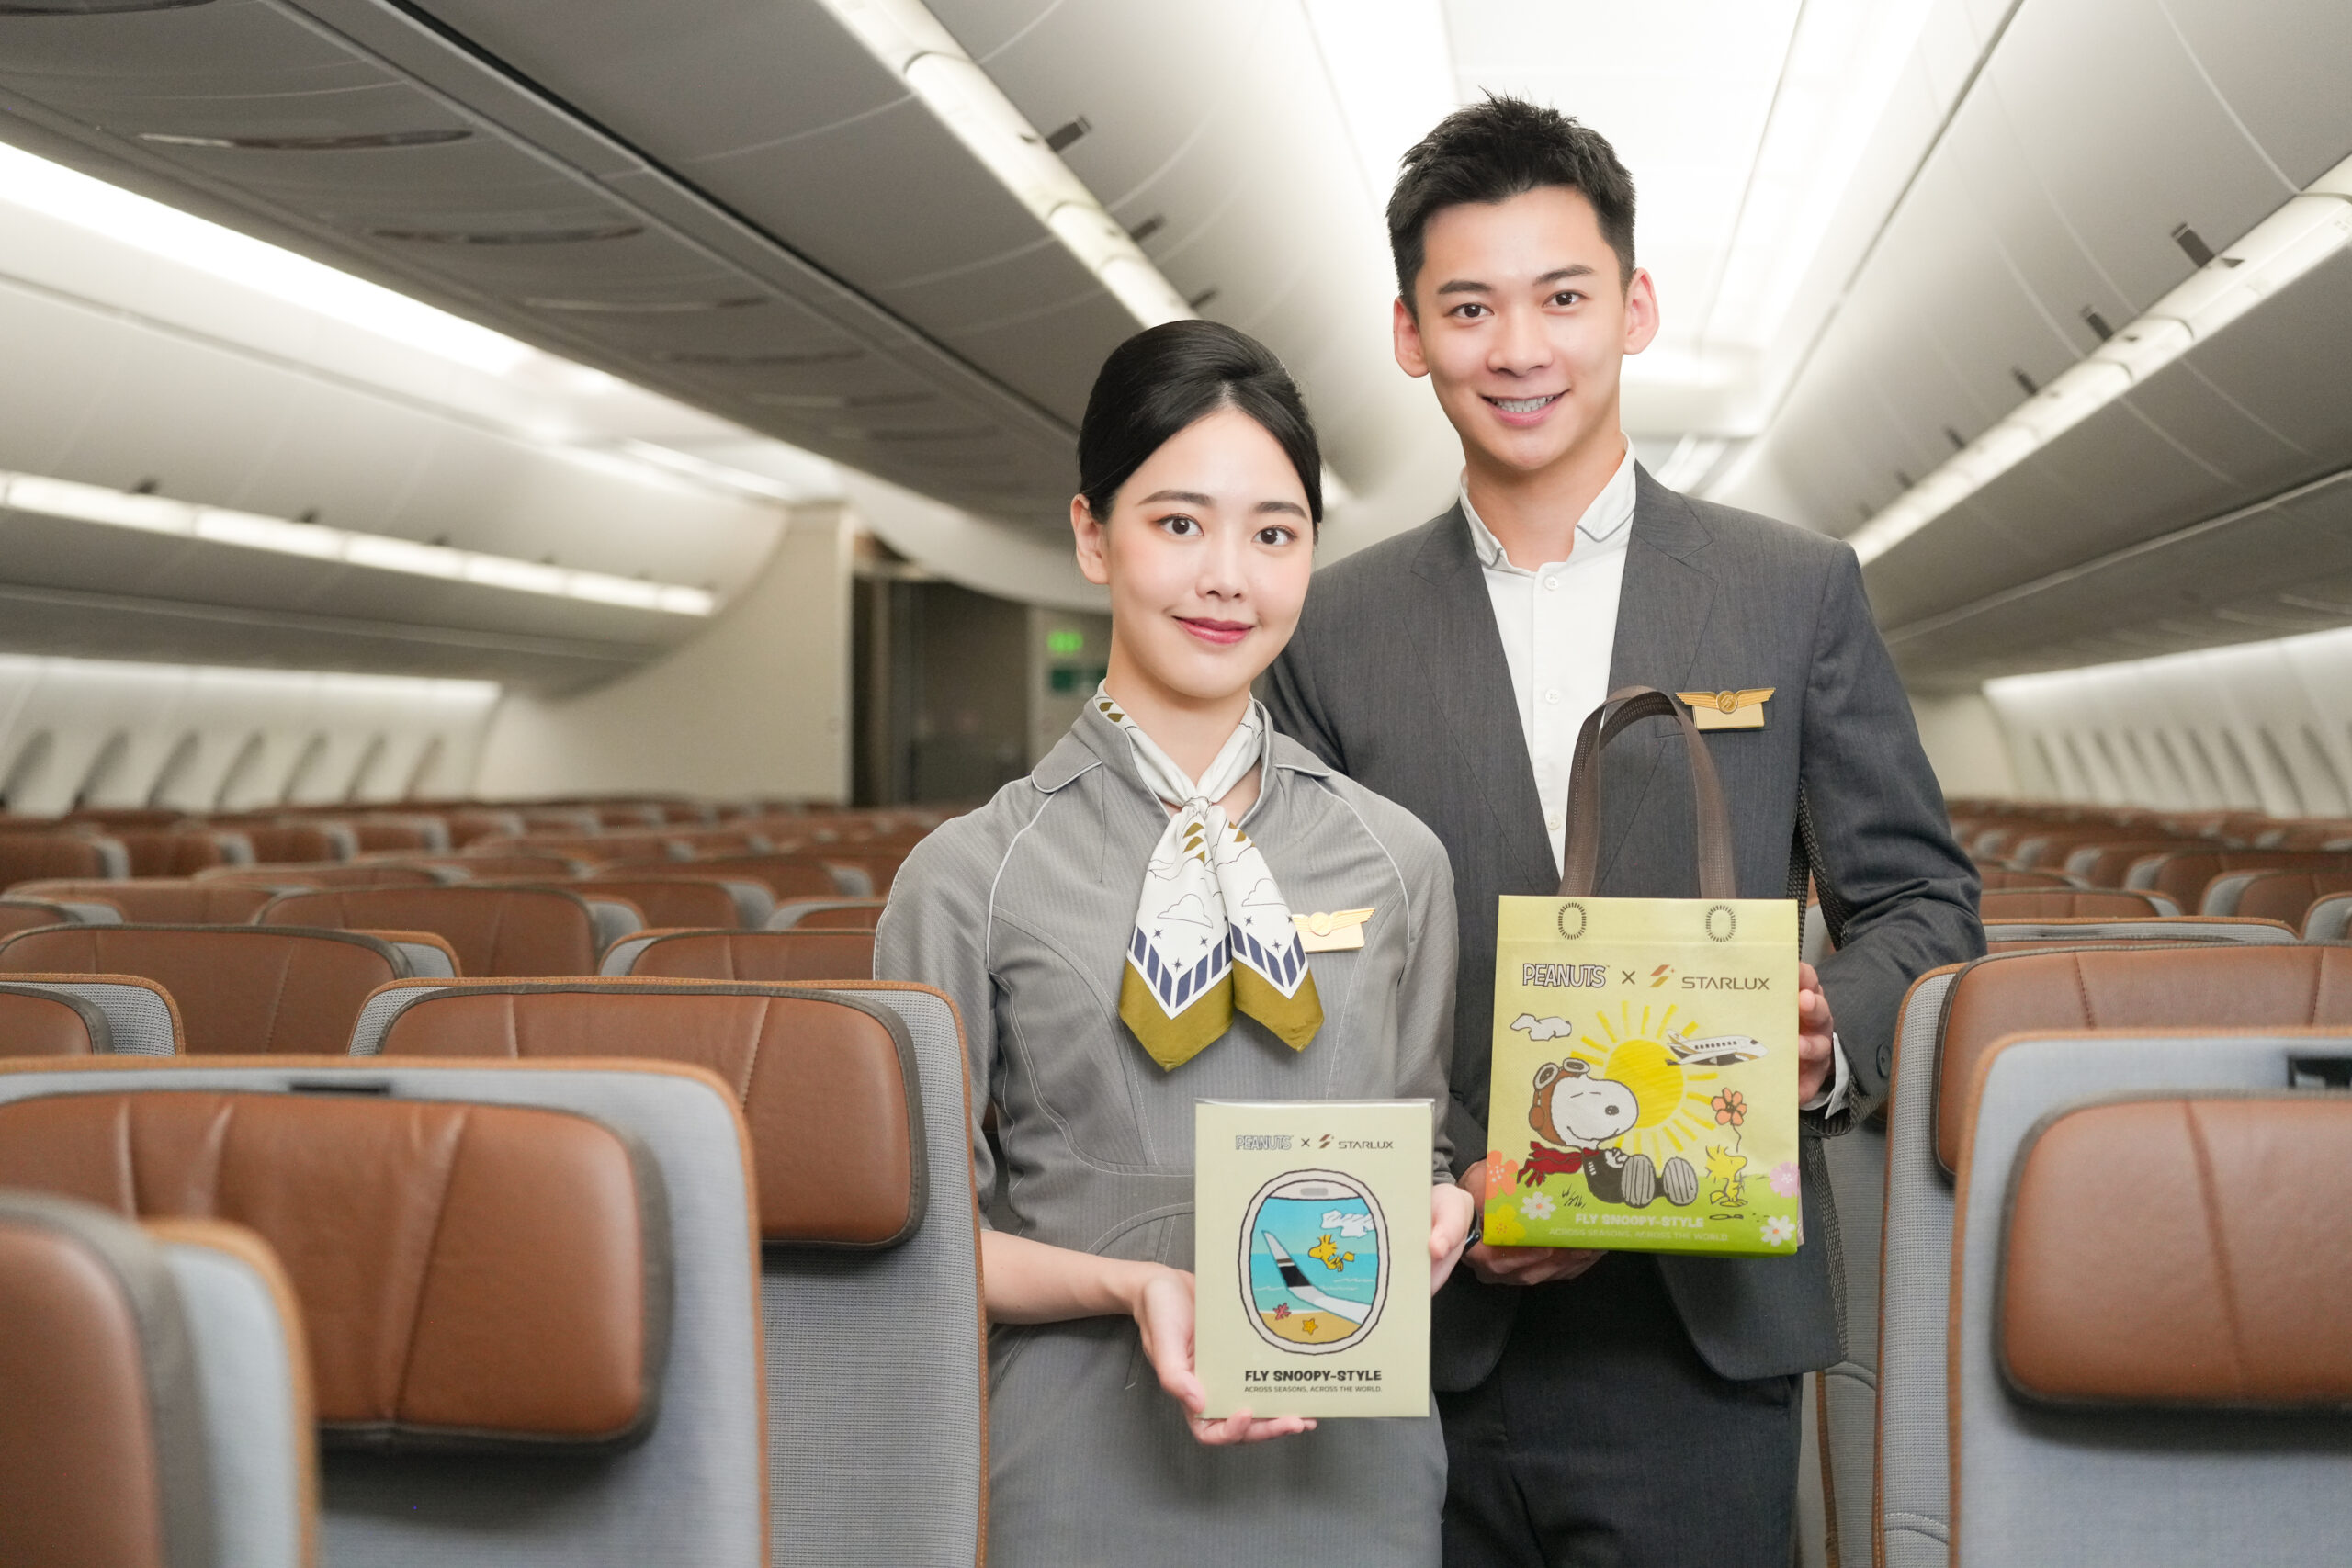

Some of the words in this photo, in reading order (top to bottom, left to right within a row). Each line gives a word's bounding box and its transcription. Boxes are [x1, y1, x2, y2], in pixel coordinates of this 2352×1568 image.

[1522, 963, 1607, 988] PEANUTS
[1681, 976, 1770, 990] STARLUX
[1235, 1134, 1293, 1150] PEANUTS
[1338, 1141, 1394, 1149] STARLUX
[1575, 1213, 1599, 1224] FLY
[1601, 1214, 1704, 1228] SNOOPY-STYLE
[1549, 1227, 1586, 1236] ACROSS
[1634, 1230, 1671, 1239] ACROSS
[1674, 1232, 1691, 1240] THE
[1245, 1371, 1270, 1382] FLY
[1273, 1370, 1383, 1382] SNOOPY-STYLE
